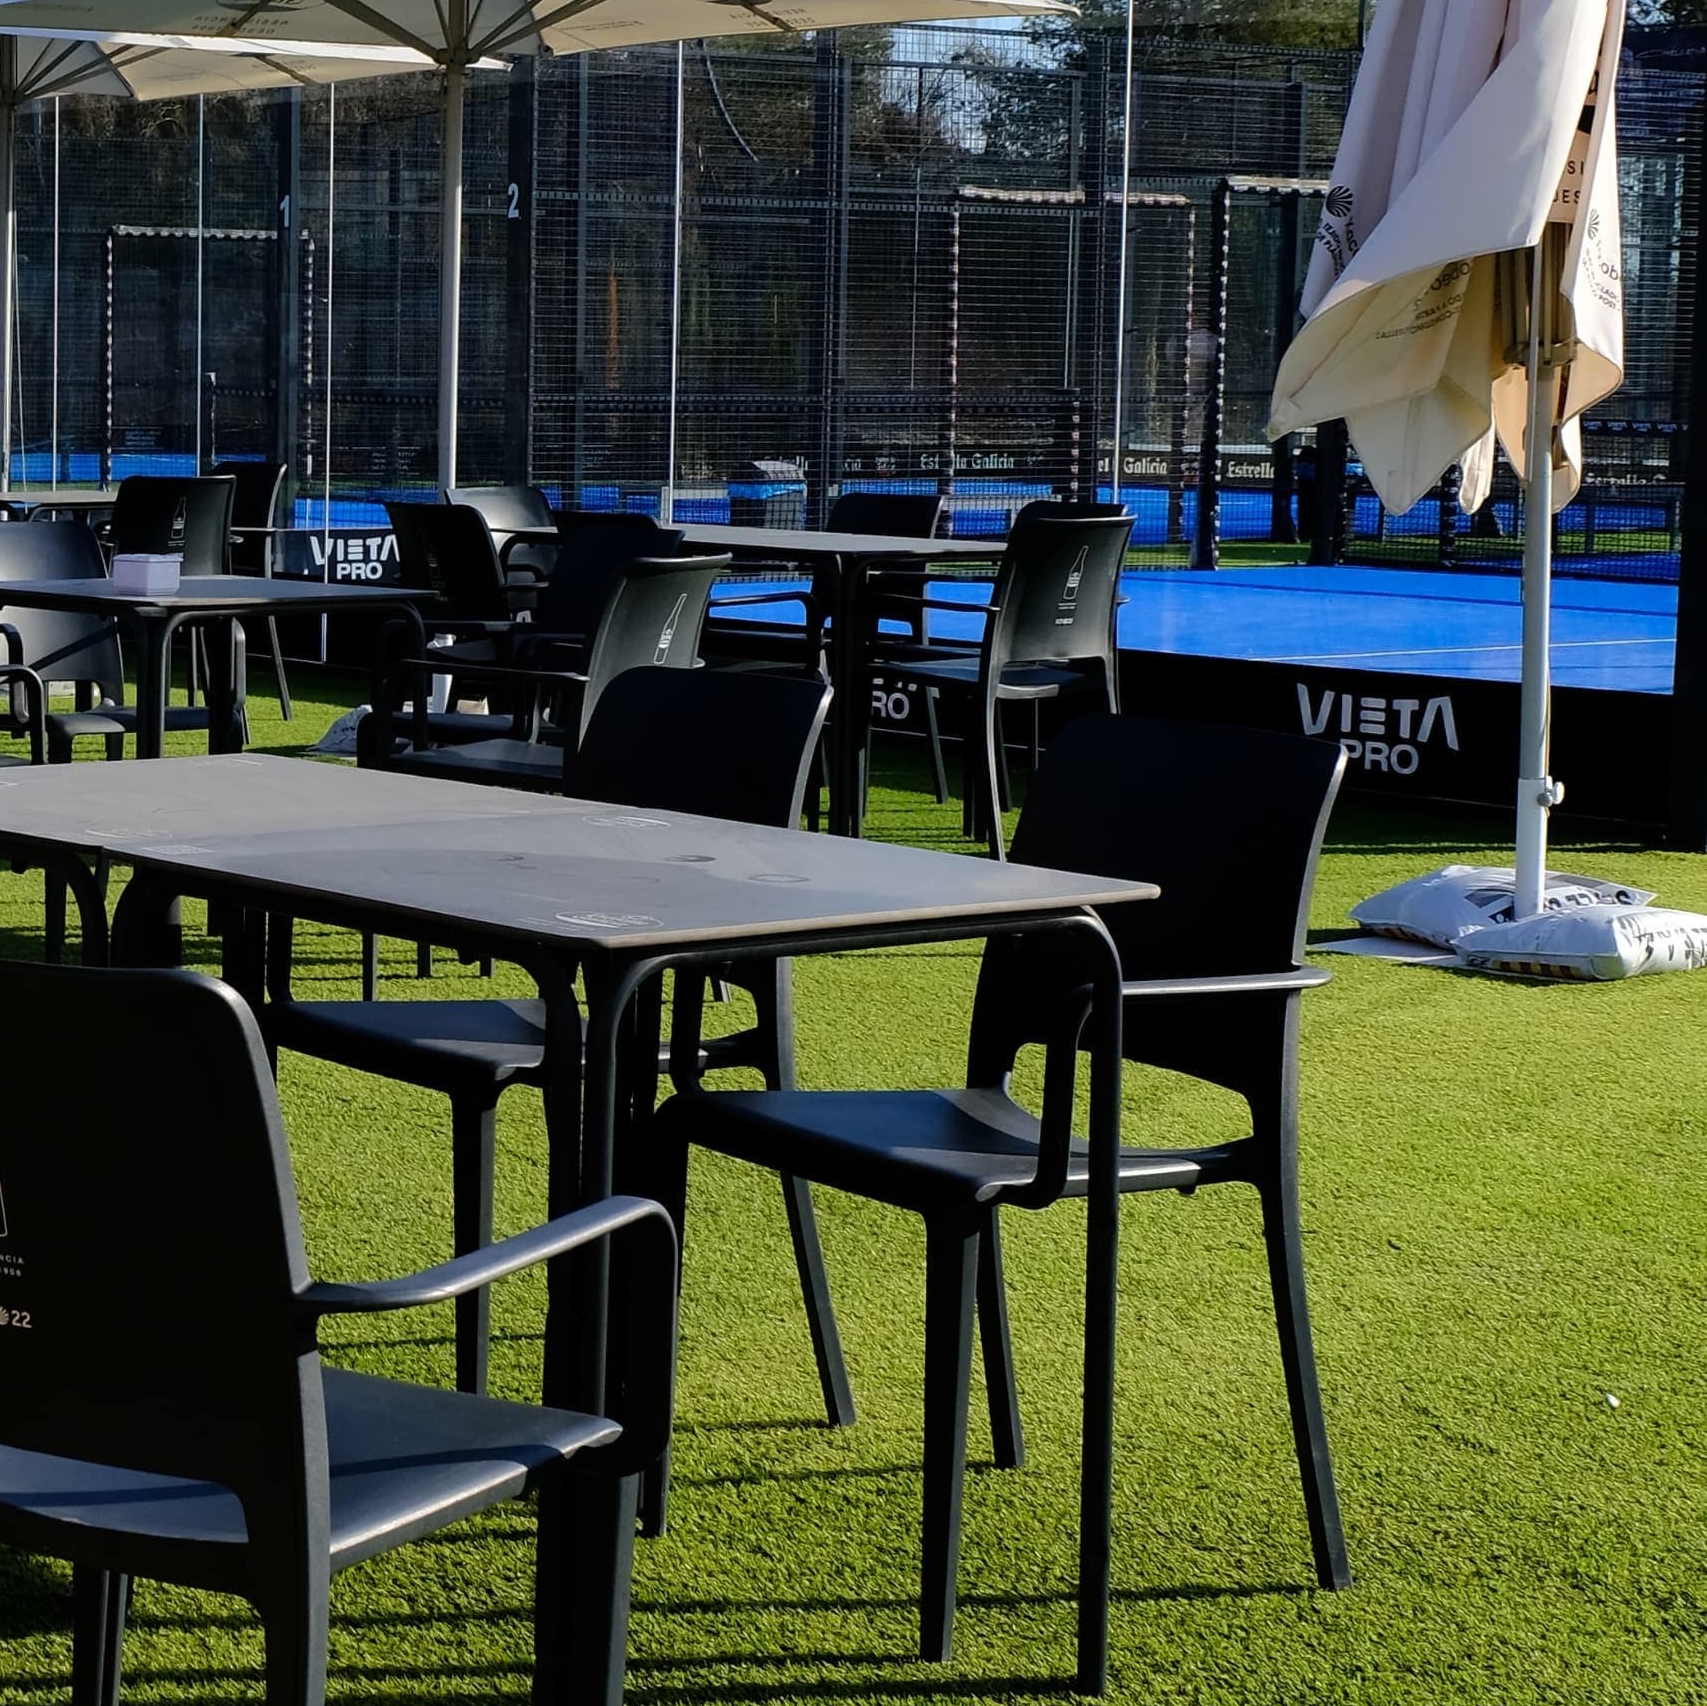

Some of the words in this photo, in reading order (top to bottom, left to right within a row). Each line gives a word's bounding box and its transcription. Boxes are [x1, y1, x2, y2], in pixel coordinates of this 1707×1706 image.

[280, 195, 290, 228] 1
[507, 182, 520, 220] 2
[1123, 455, 1168, 475] Galicia
[310, 534, 400, 566] VIETA
[336, 561, 383, 581] PRO
[872, 690, 910, 720] RO
[1296, 682, 1460, 752] VIETA
[1340, 738, 1419, 775] PRO
